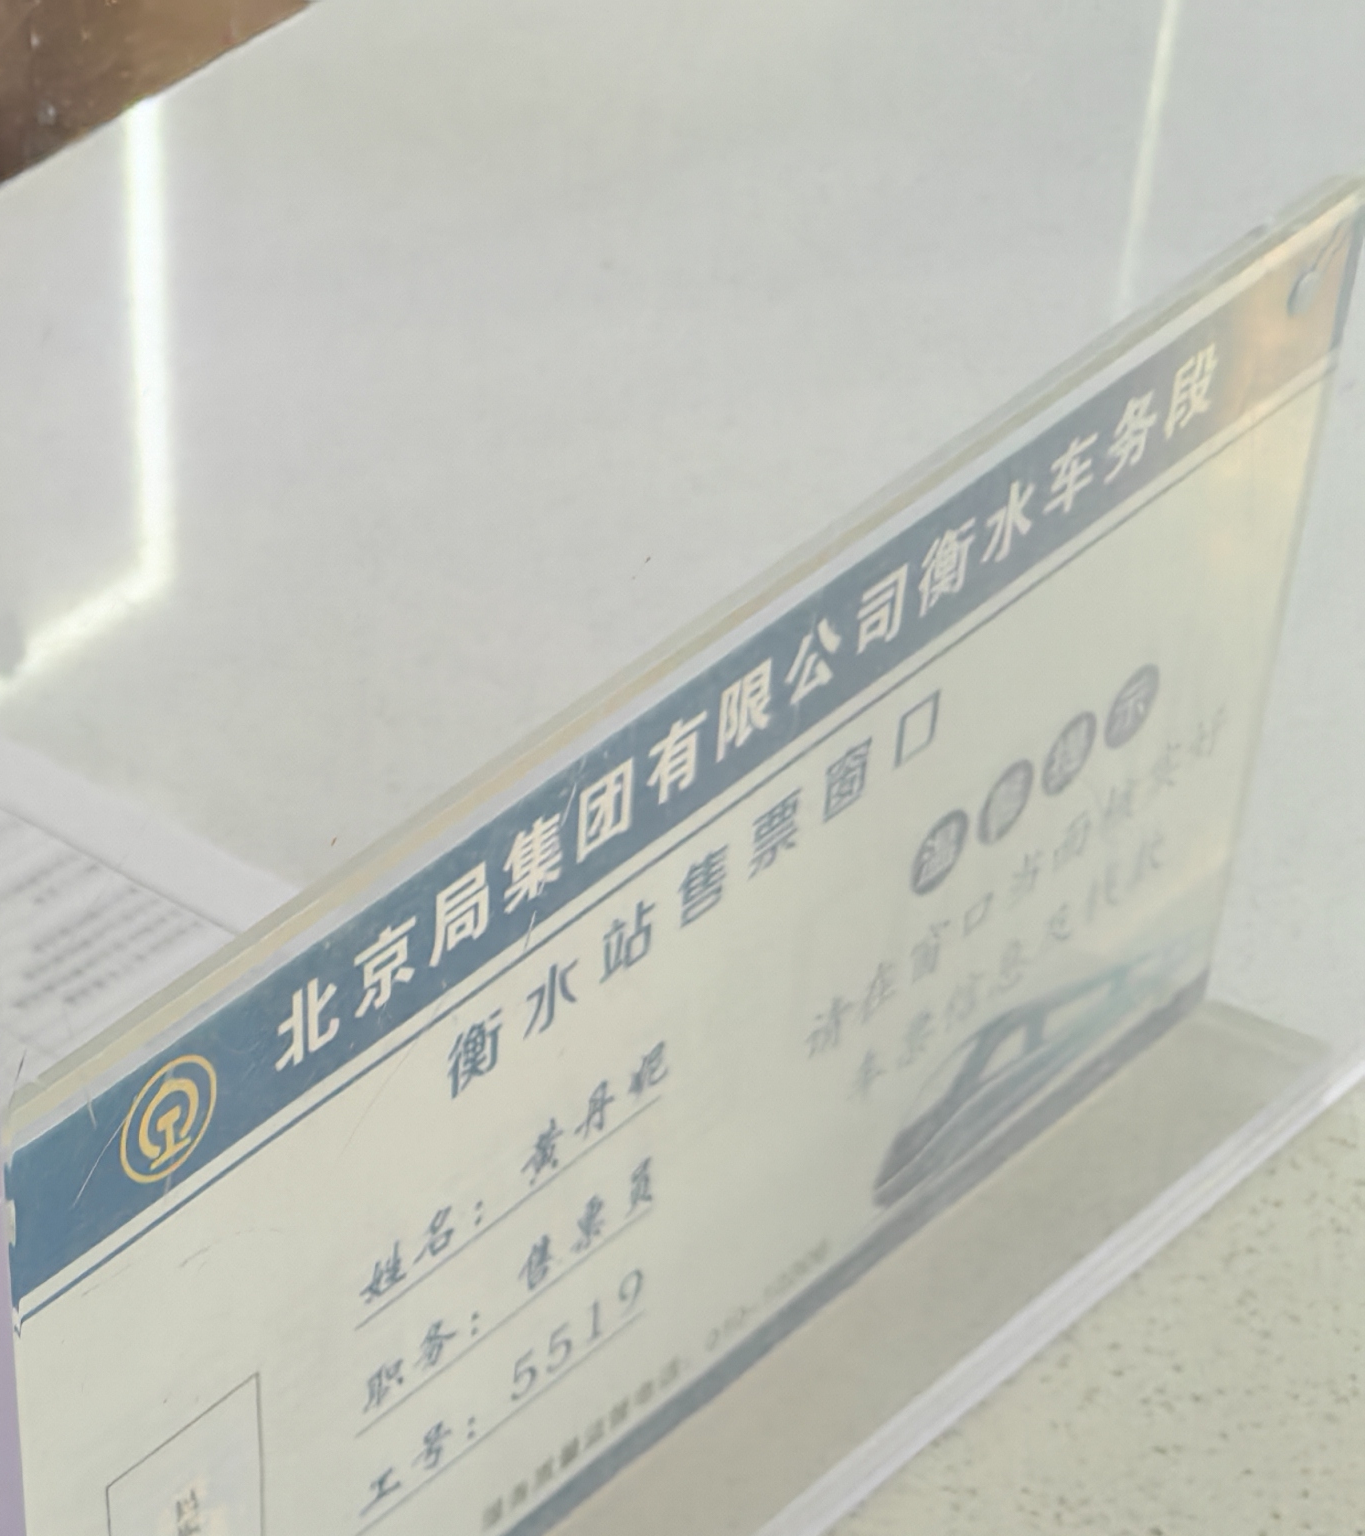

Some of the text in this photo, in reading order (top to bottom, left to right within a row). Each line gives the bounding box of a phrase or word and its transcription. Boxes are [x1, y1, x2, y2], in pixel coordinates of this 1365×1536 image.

[273, 342, 1220, 1072] 北京局集团有限公司衡水车务段
[447, 688, 941, 1099] 衡水站售票窗口
[511, 1267, 644, 1402] 5519
